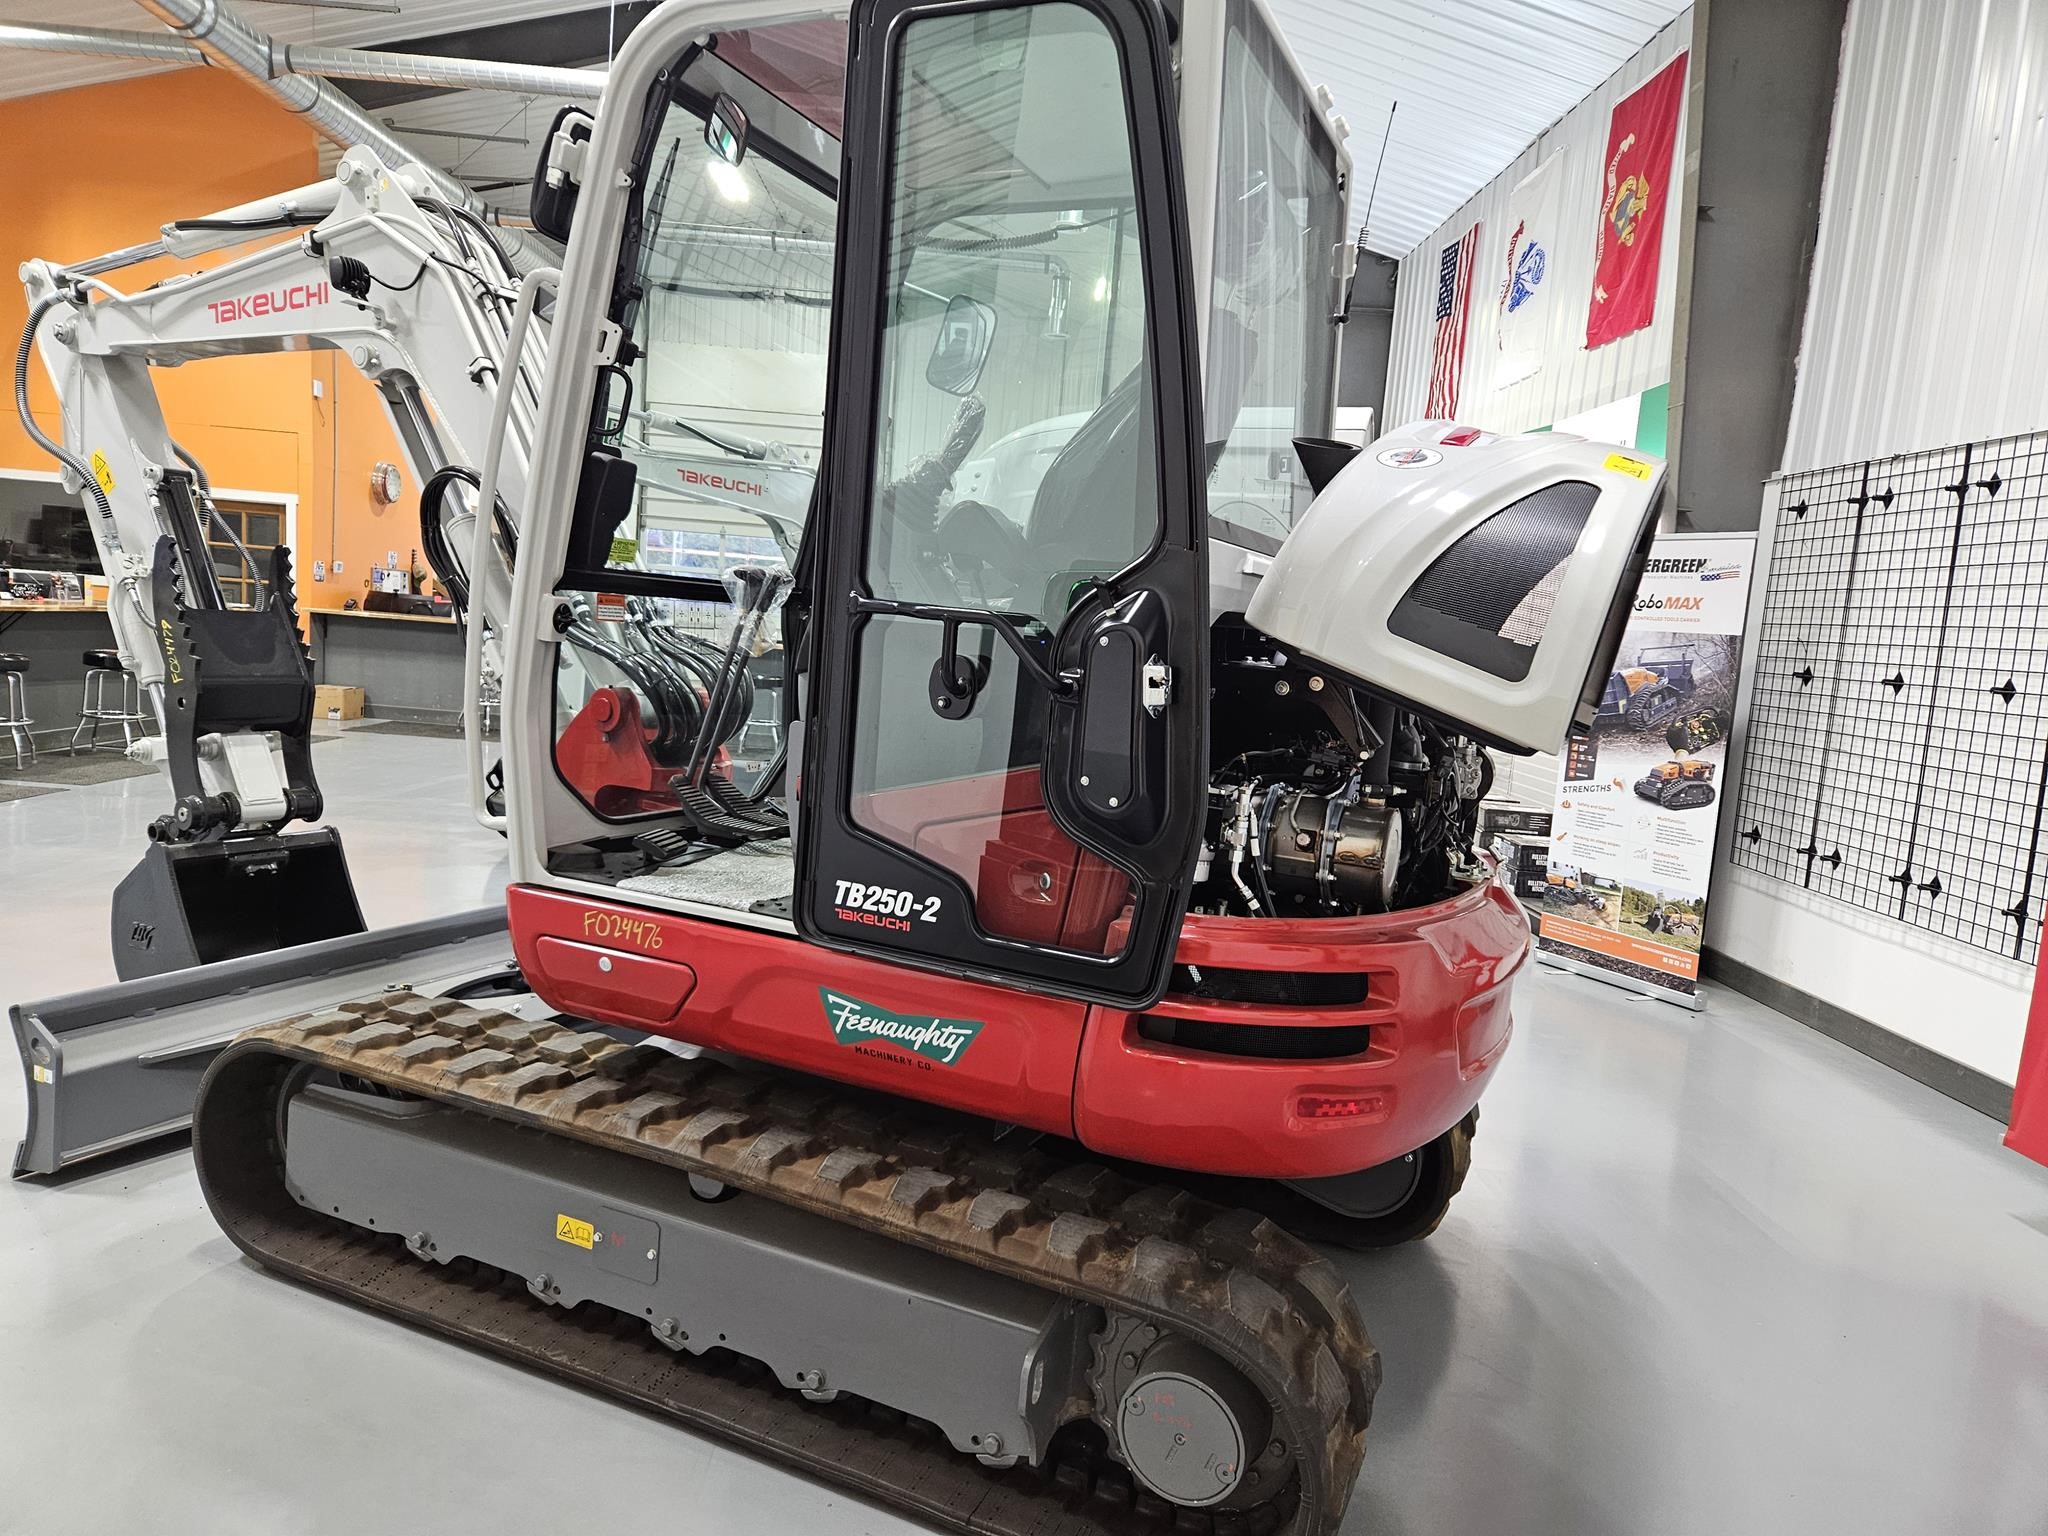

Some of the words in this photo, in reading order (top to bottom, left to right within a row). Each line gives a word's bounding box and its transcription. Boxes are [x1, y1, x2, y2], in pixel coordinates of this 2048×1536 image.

[208, 281, 329, 324] TAKEUCHI
[677, 468, 763, 497] TAKEUCHI
[1562, 784, 1612, 794] STRENGTHS
[834, 879, 942, 923] TB250-2
[835, 907, 911, 932] TAKEUCHI
[827, 993, 973, 1063] Feenaughty
[854, 1045, 913, 1067] MACHINERY
[917, 1061, 935, 1072] CO.
